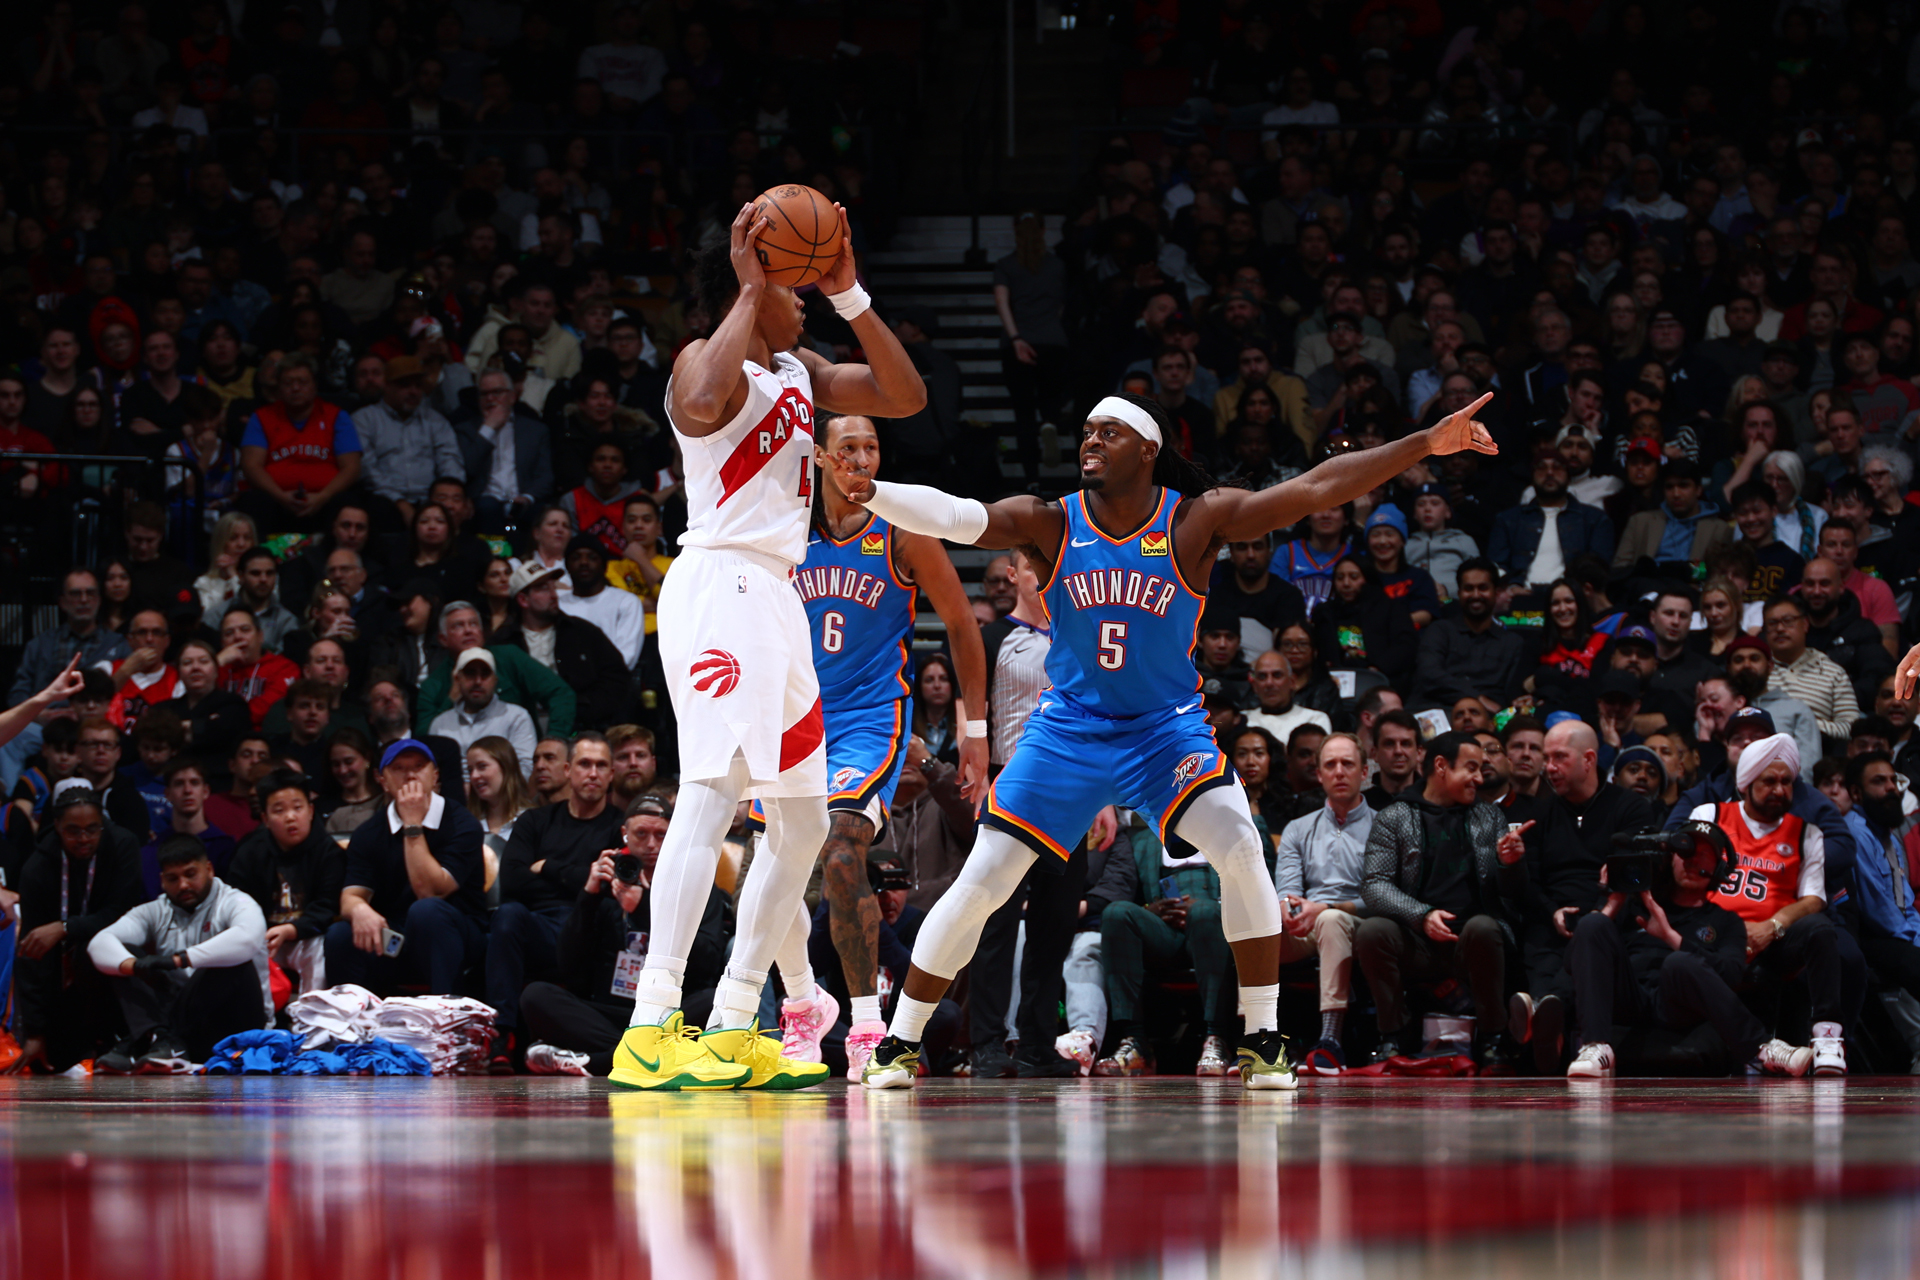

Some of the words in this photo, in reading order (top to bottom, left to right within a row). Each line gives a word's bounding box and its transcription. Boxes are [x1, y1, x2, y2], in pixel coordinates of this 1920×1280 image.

[758, 395, 814, 454] RAPTO
[270, 444, 330, 462] RAPTORS
[1142, 546, 1167, 554] Love's
[793, 565, 888, 611] THUNDER
[1062, 567, 1178, 619] THUNDER
[1744, 565, 1785, 595] BC
[821, 610, 846, 654] 6
[1097, 620, 1129, 672] 5
[1719, 868, 1768, 902] 95
